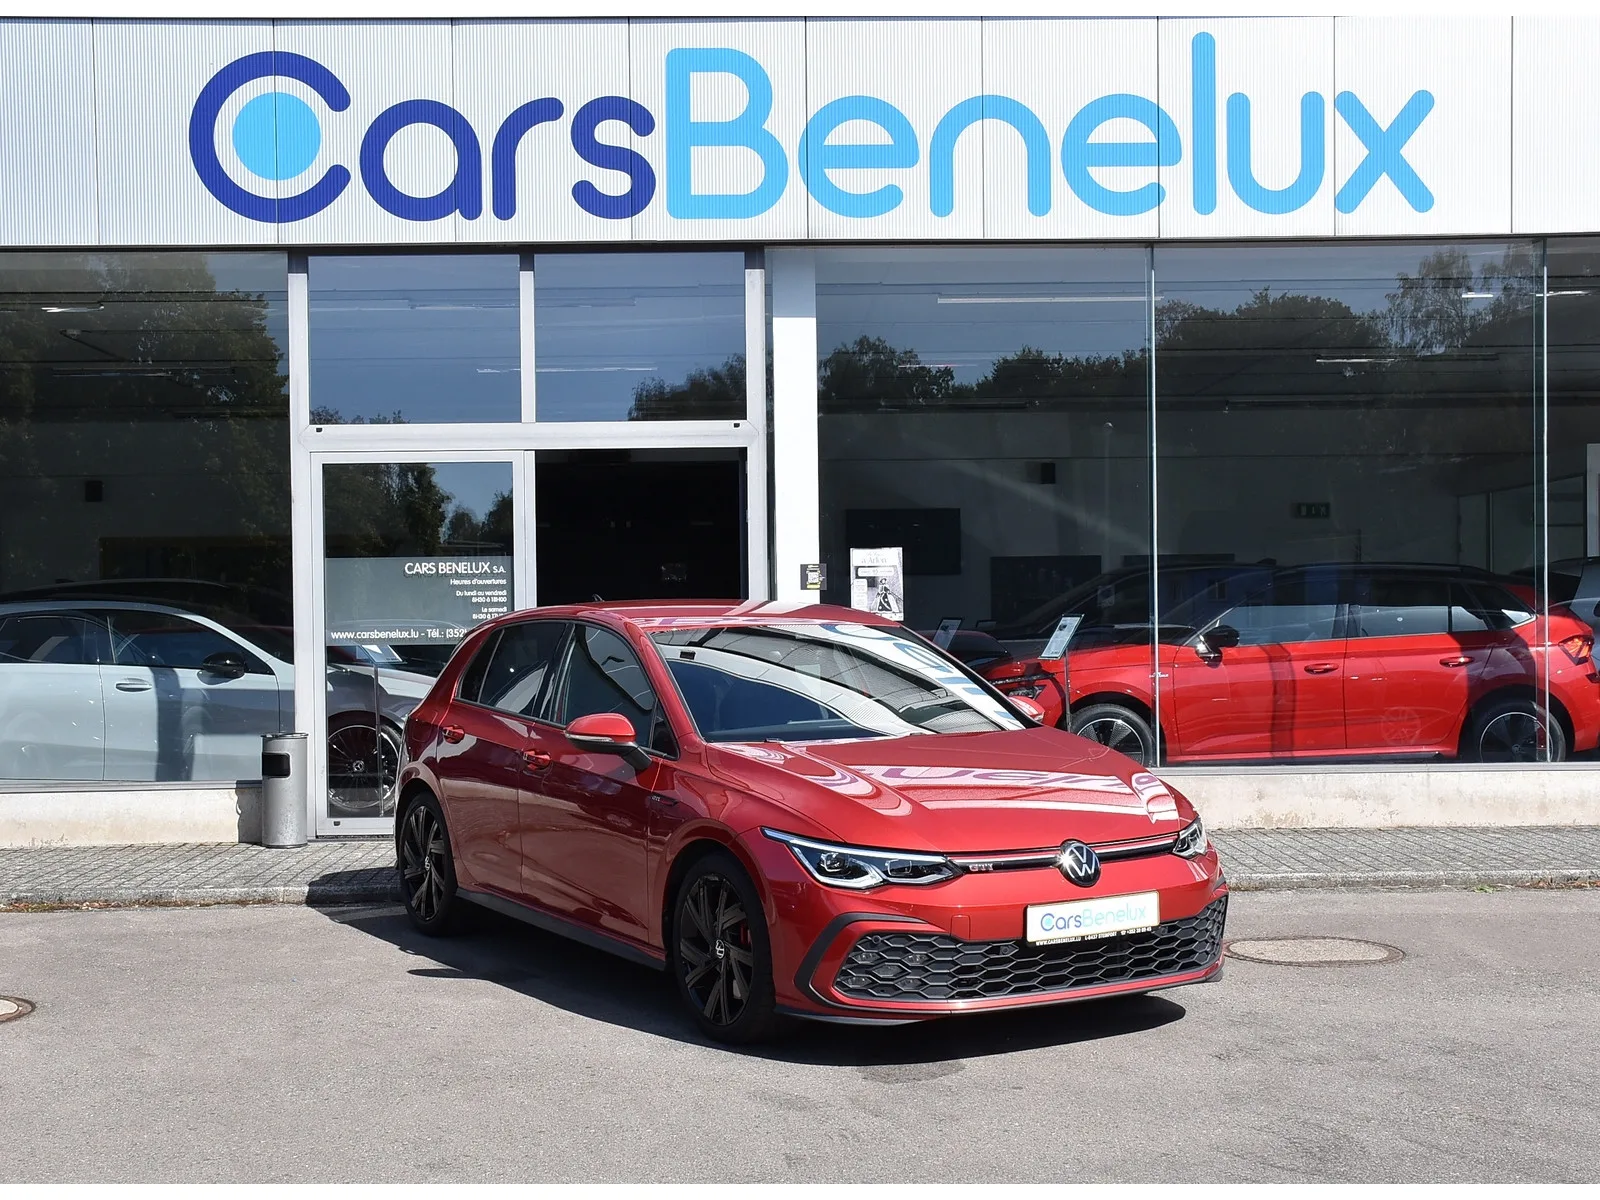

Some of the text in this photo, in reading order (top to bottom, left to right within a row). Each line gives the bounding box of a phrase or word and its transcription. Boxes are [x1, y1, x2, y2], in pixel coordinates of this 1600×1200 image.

[189, 32, 1435, 223] CarsBenelux
[404, 561, 507, 574] CARS BENELUX S.A.
[331, 629, 419, 640] www.carsbenelux.lu
[427, 628, 444, 638] Tél.:
[969, 863, 994, 871] GTI
[1040, 903, 1146, 931] CarsBenelux
